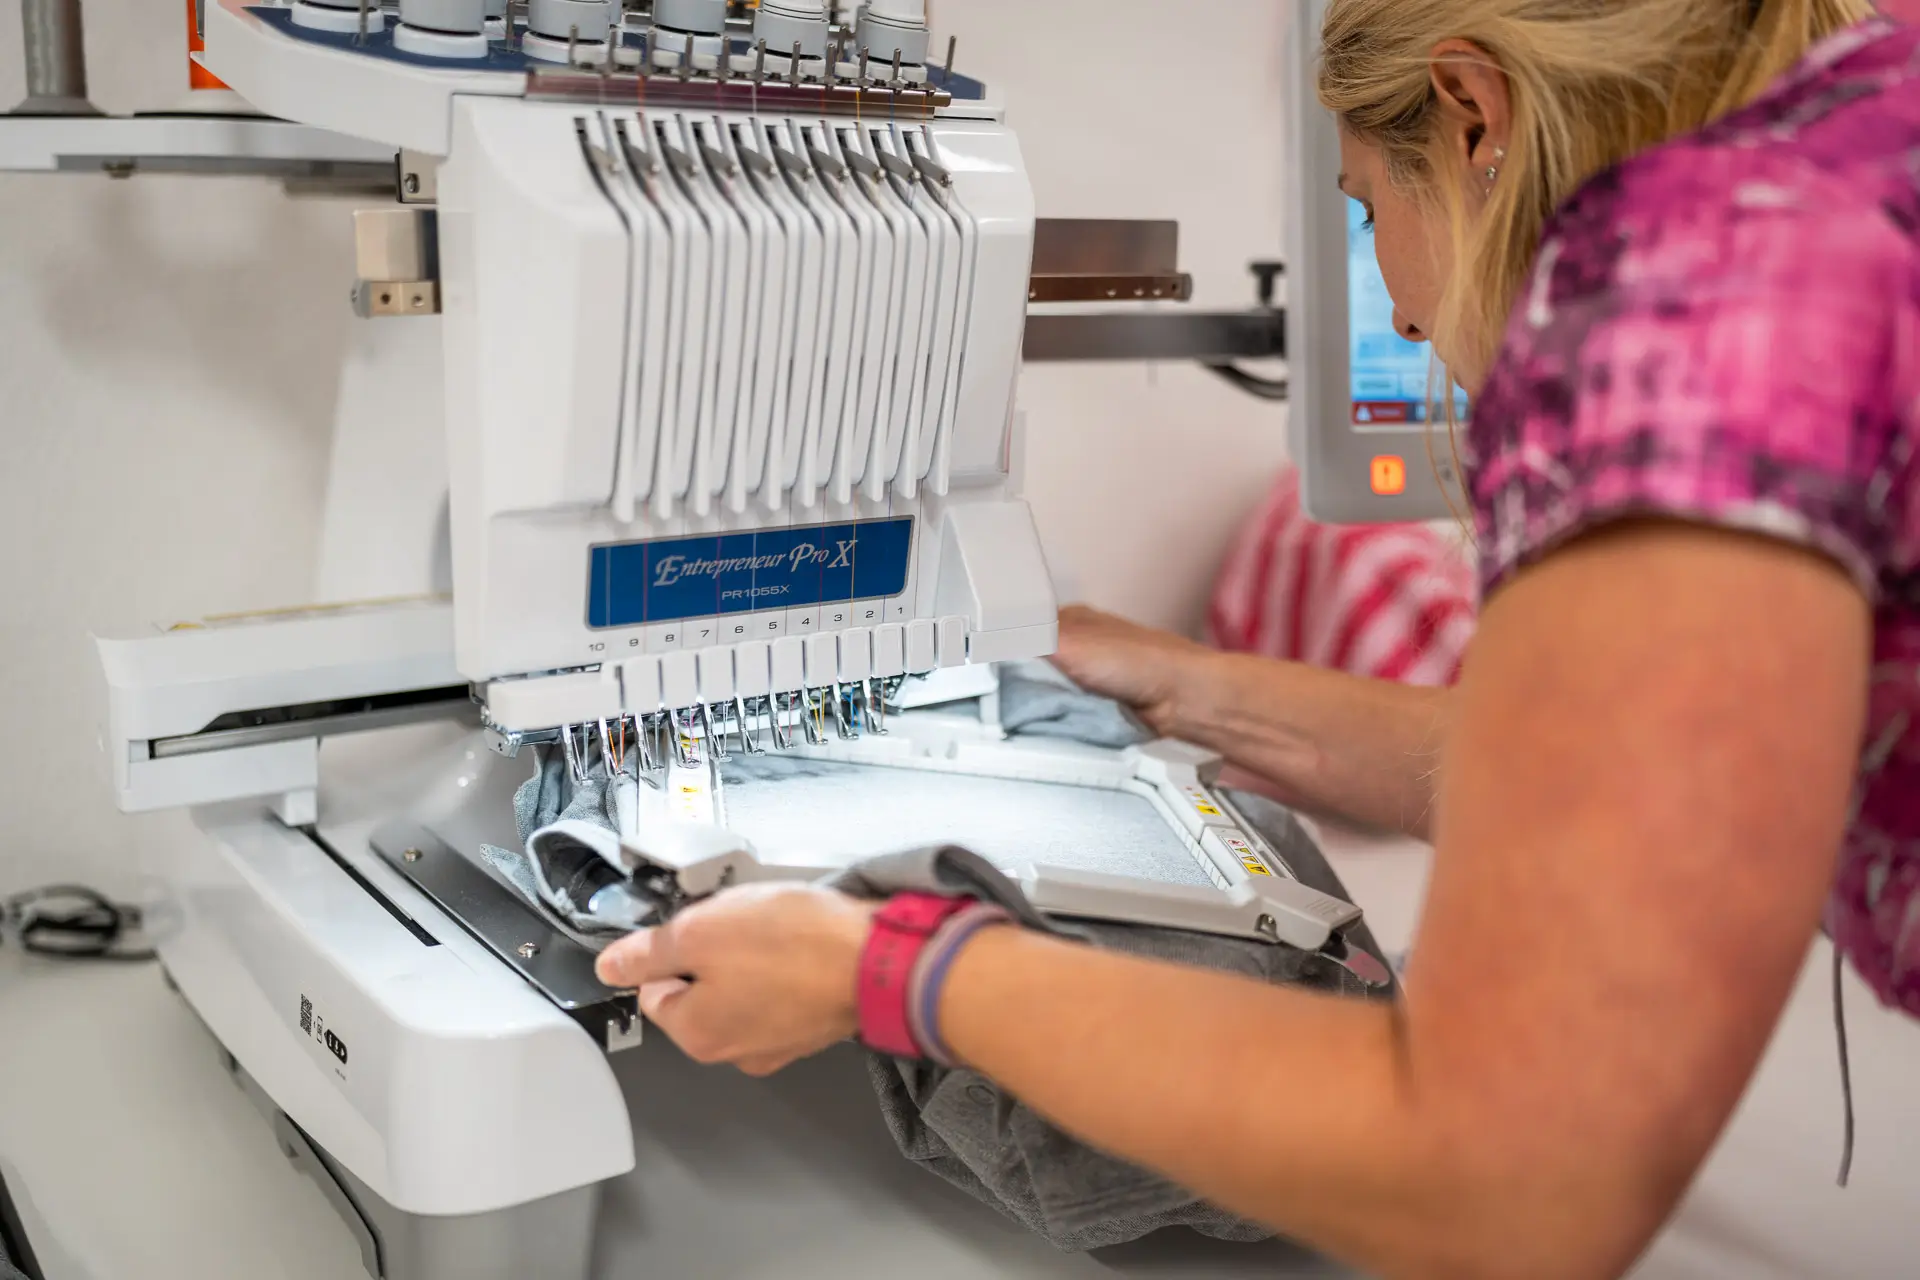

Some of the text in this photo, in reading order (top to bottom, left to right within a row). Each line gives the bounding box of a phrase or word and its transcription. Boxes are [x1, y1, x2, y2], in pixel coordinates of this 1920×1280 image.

[653, 539, 858, 587] Entrepreneur Pro X
[722, 584, 791, 600] PR1055X
[588, 643, 605, 652] 10
[629, 639, 639, 647] 9
[665, 634, 675, 642] 8
[701, 629, 710, 638] 7
[734, 625, 744, 634] 6
[768, 621, 778, 630] 5
[801, 617, 811, 625] 4
[834, 614, 843, 622] 3
[865, 610, 874, 618] 2
